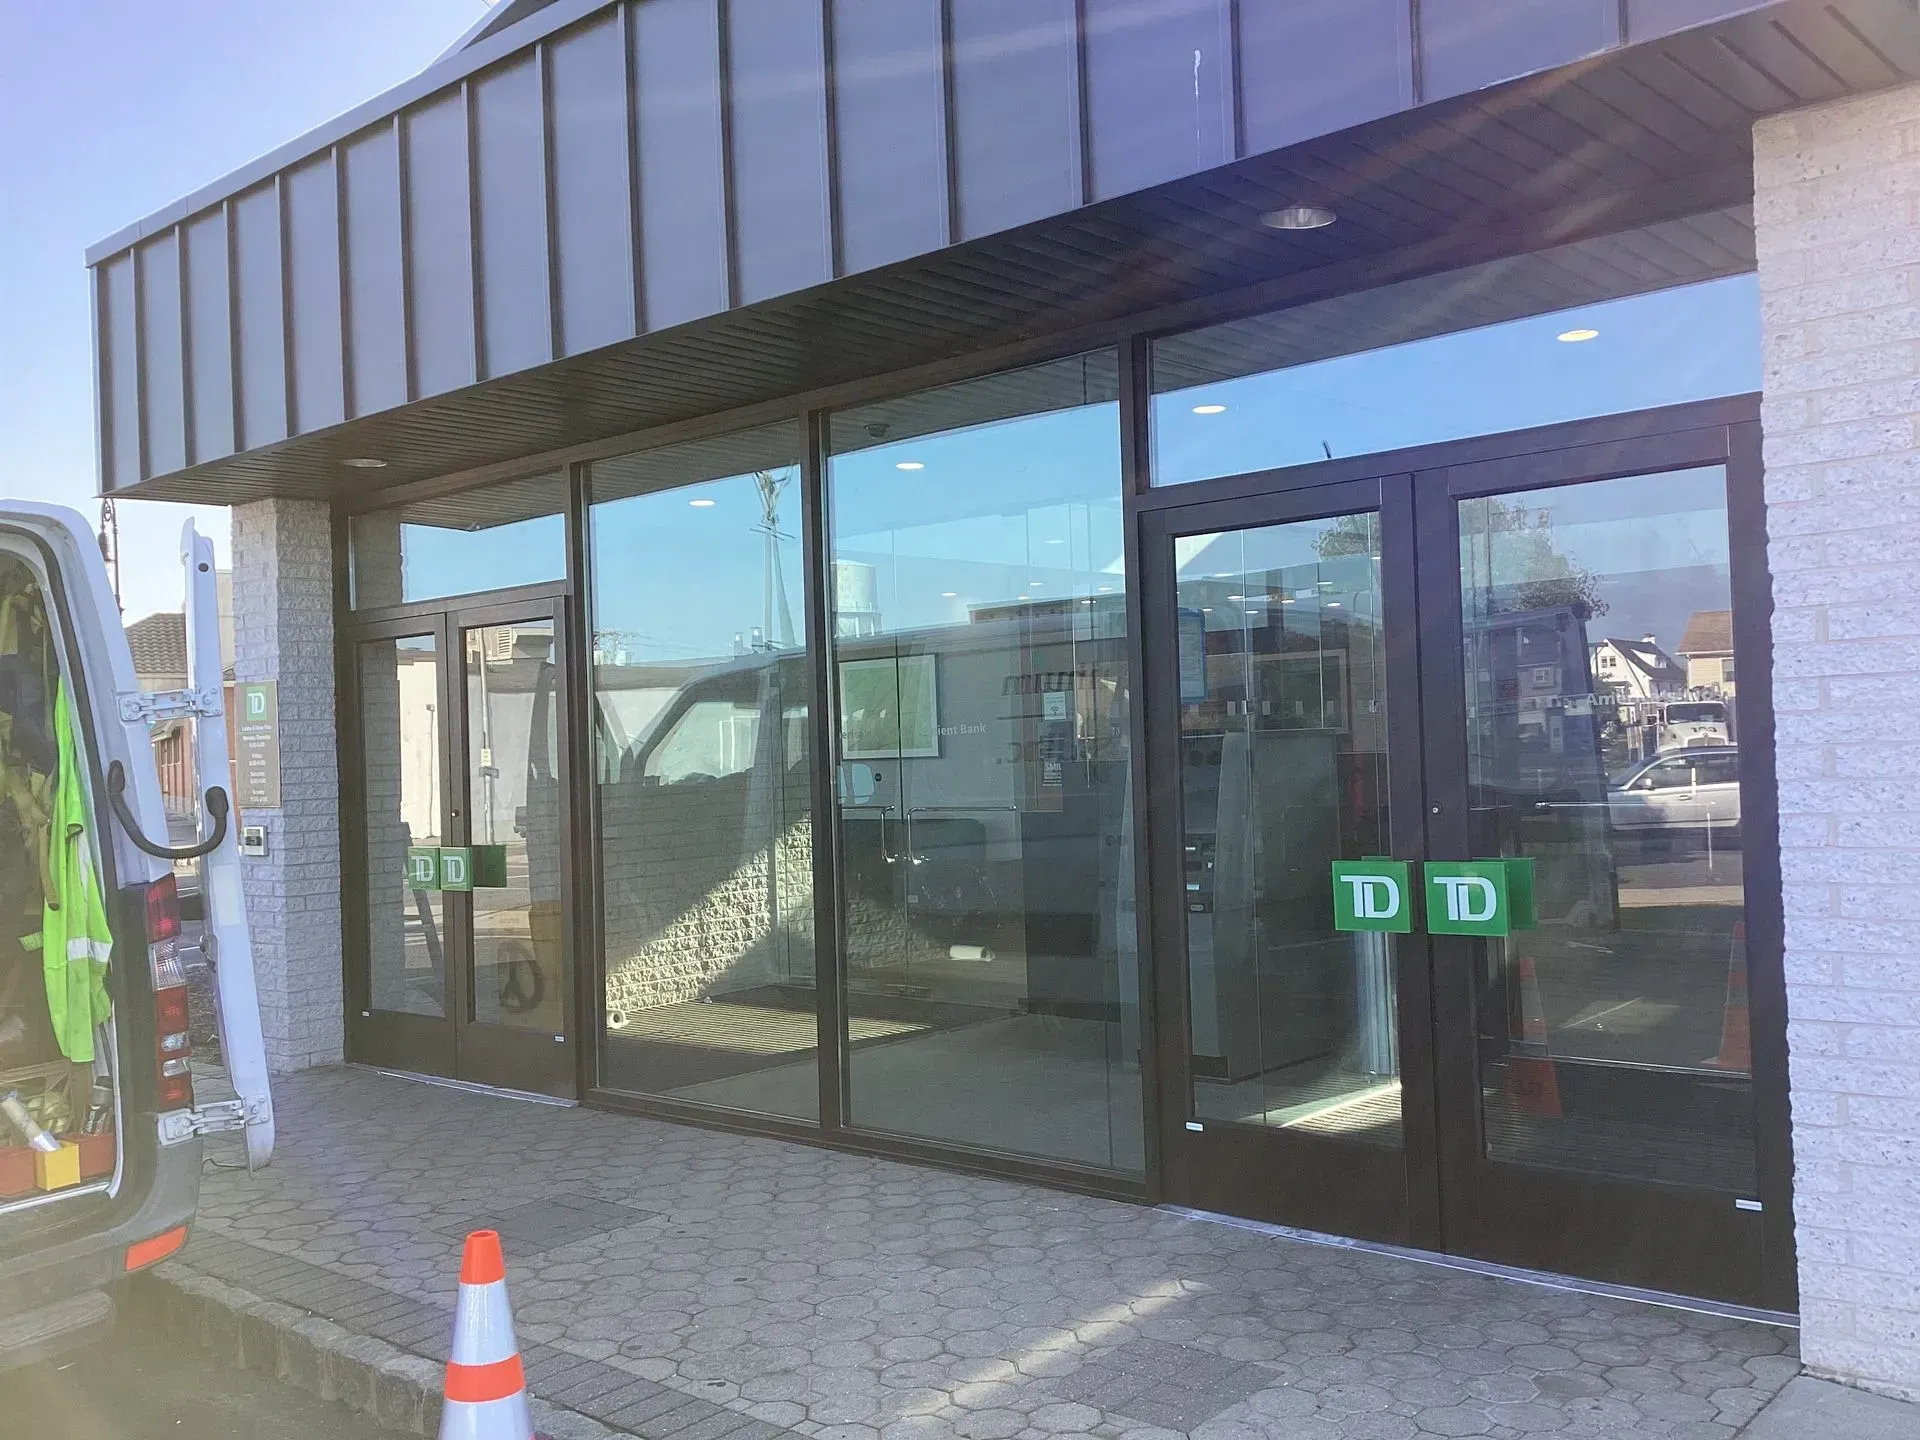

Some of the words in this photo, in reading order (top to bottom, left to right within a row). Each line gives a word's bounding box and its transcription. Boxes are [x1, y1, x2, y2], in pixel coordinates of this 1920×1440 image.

[248, 692, 264, 714] TD
[960, 723, 986, 735] Bank
[411, 855, 434, 882] TD
[443, 856, 465, 883] TD
[1340, 875, 1400, 919] TD
[1433, 876, 1497, 922] TD
